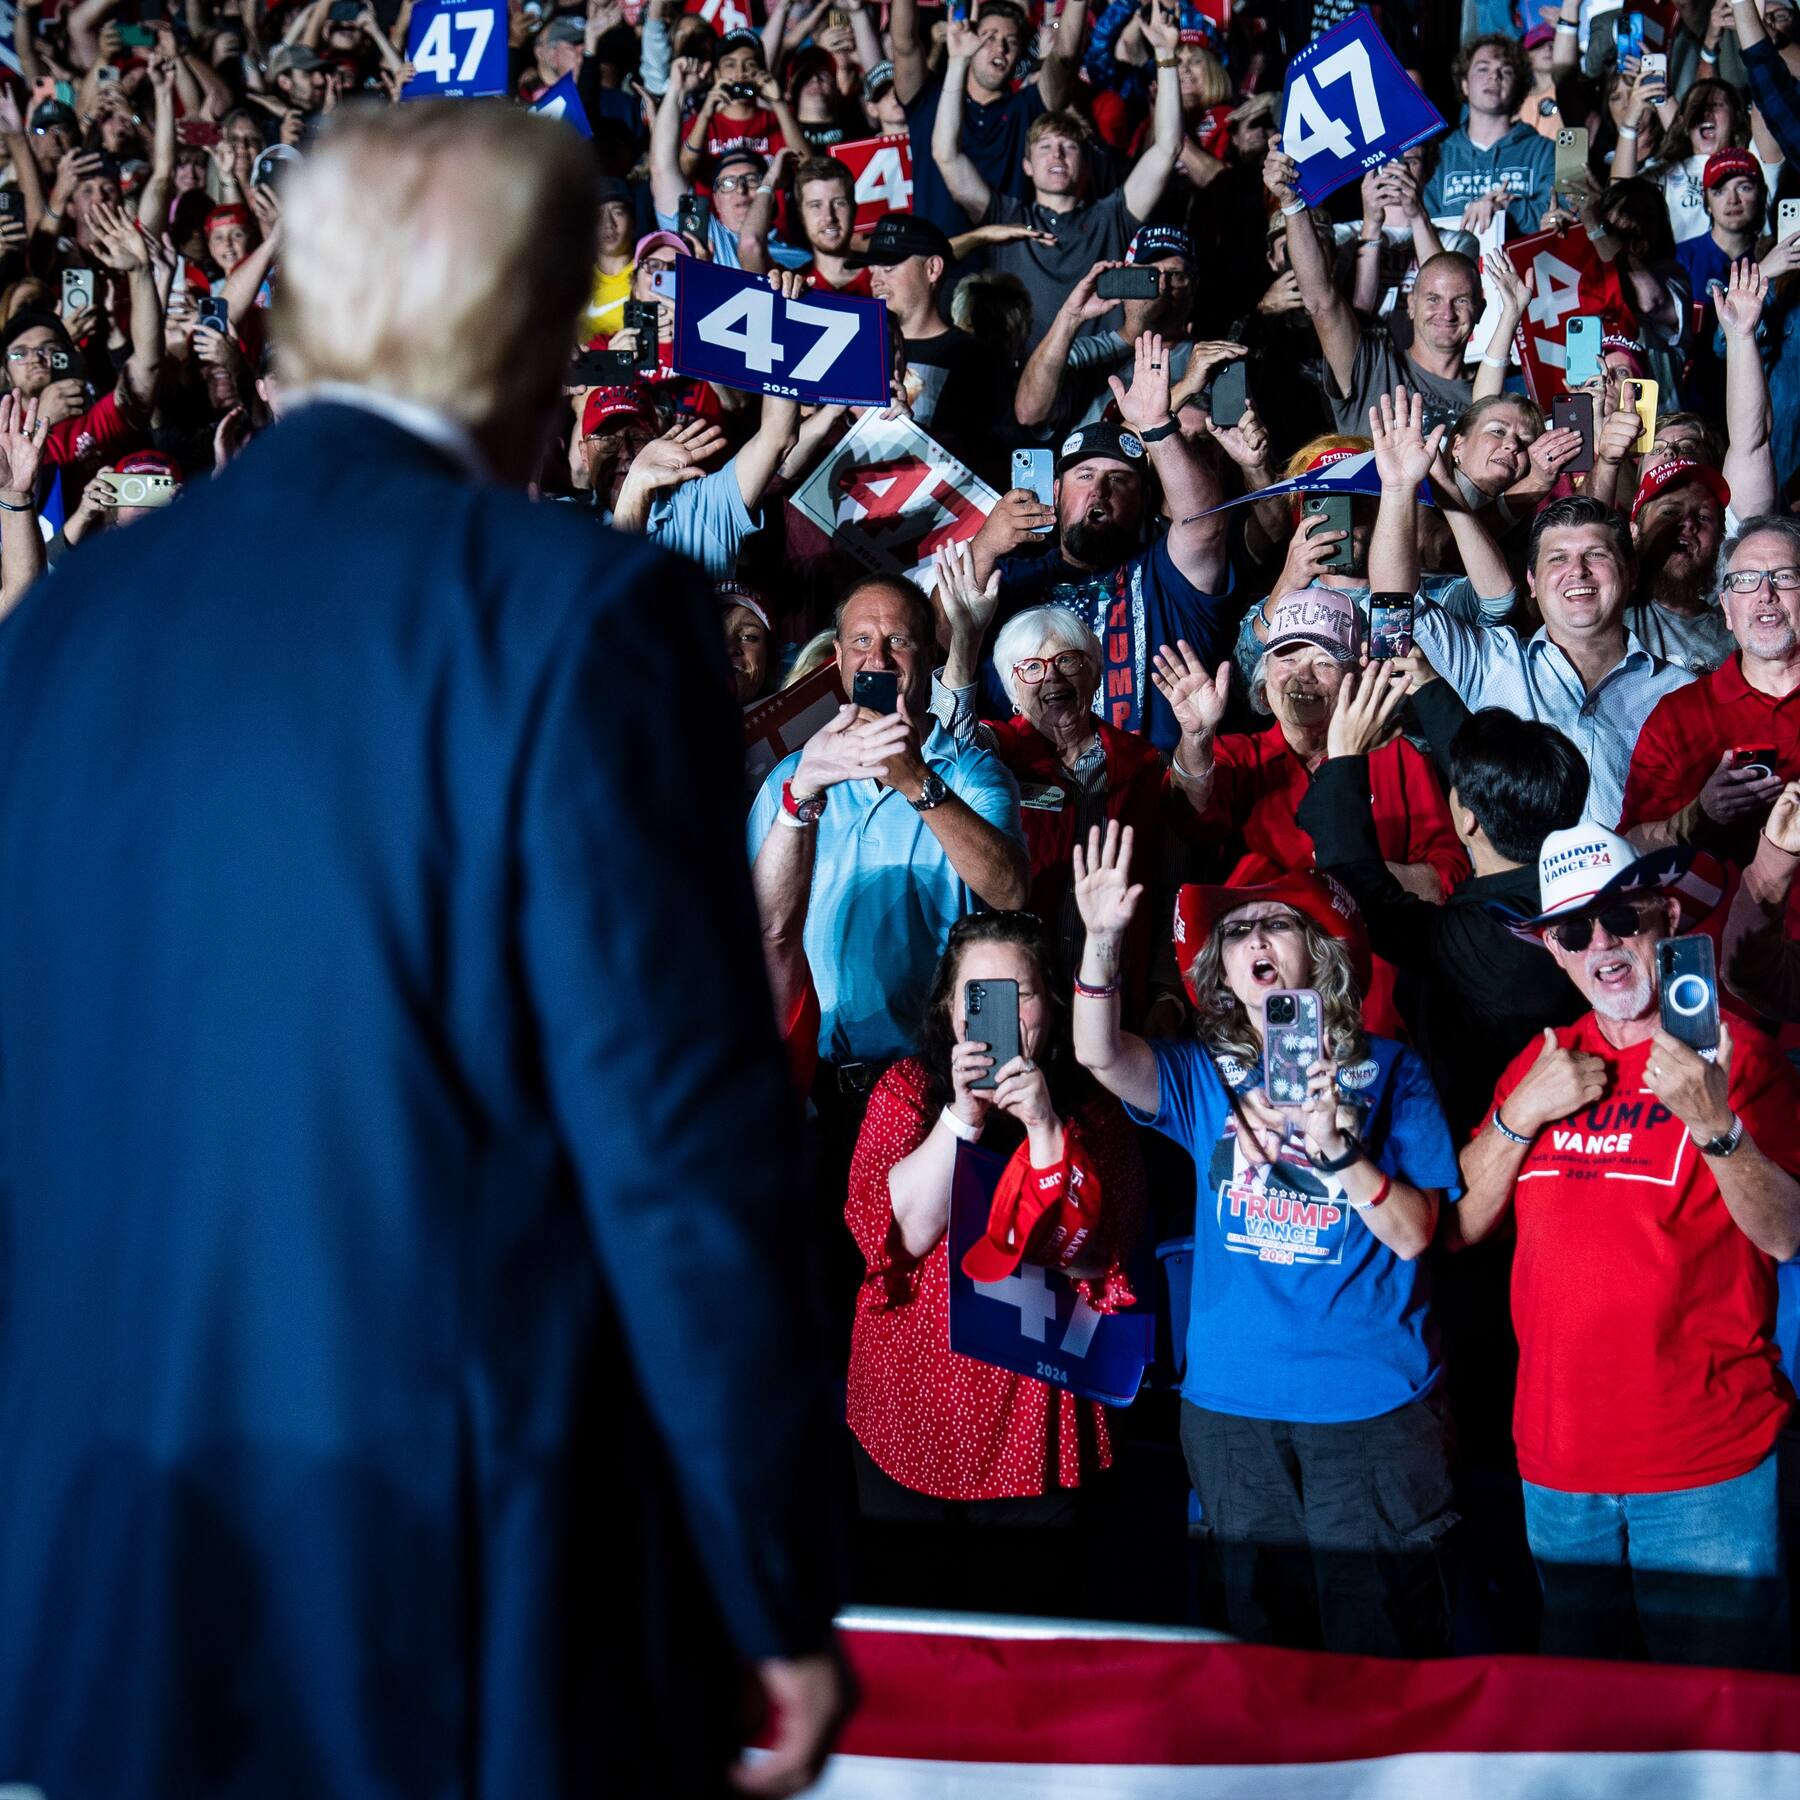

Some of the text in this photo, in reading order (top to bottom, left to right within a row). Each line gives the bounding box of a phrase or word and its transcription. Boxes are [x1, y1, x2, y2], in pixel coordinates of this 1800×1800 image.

[412, 9, 494, 83] 47
[1283, 38, 1386, 163] 47
[1361, 150, 1387, 168] 2024
[697, 287, 860, 382] 47
[1516, 319, 1527, 350] 024
[1602, 335, 1642, 352] RUMP
[763, 382, 799, 397] 2024
[1320, 451, 1358, 466] Trum
[1650, 461, 1678, 479] MAKE
[1289, 483, 1331, 492] 2024
[1656, 467, 1682, 485] GREA
[1276, 602, 1353, 635] TRUMP
[1543, 843, 1608, 871] TRUMP
[1544, 858, 1588, 883] VANCE
[1553, 1130, 1632, 1154] VANCE
[1227, 1188, 1341, 1230] TRUMP
[1245, 1216, 1317, 1245] VANCE
[1259, 1248, 1294, 1265] 2024
[1036, 1361, 1068, 1383] 2024
